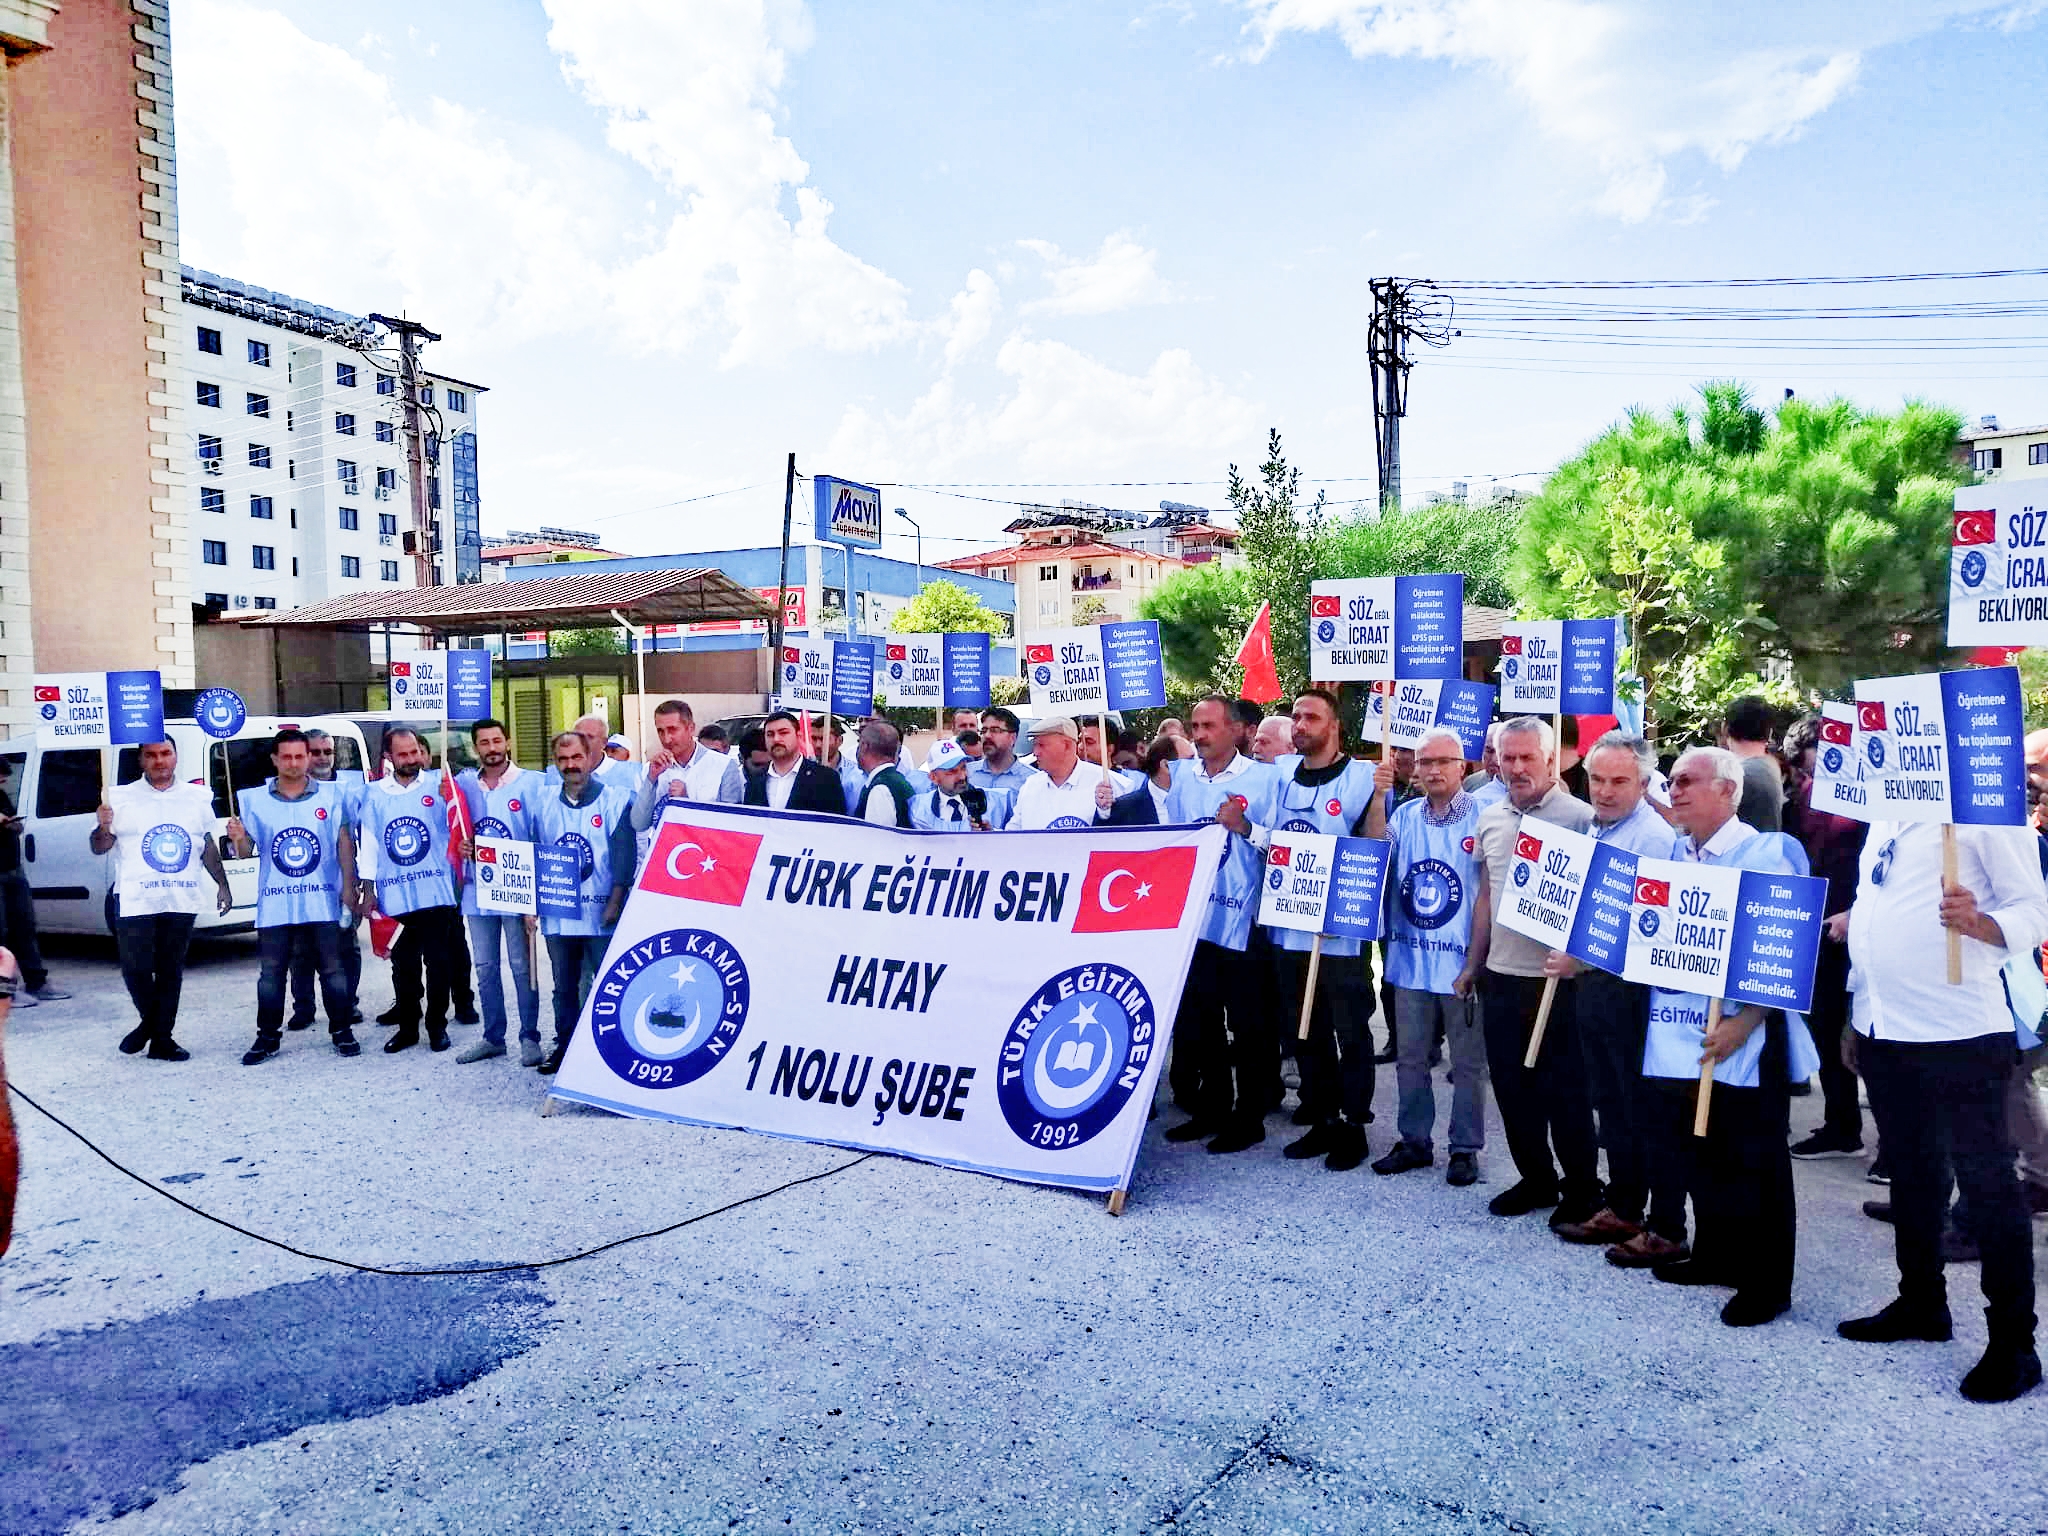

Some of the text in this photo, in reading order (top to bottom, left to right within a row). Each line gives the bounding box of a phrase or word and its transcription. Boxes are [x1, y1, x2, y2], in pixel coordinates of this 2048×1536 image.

[832, 488, 876, 526] Mavi
[2008, 506, 2047, 549] SÖZ
[2006, 554, 2048, 589] İCRA
[1412, 588, 1443, 598] Öğretmen
[1349, 596, 1374, 620] SÖZ
[1979, 594, 2048, 623] BEKLİYORU
[1113, 628, 1147, 639] Öğretmenin
[1349, 624, 1389, 644] İCRAAT
[912, 645, 928, 664] SÖZ
[1061, 643, 1084, 664] SÖZ
[1331, 648, 1388, 664] BEKLİYORUZ!
[1440, 645, 1455, 654] göre
[1528, 636, 1546, 659] SÖZ
[805, 650, 820, 669] SÖZ
[416, 662, 432, 679] SÖZ
[805, 670, 829, 686] İCRAAT
[912, 666, 939, 682] İCRAAT
[1064, 667, 1100, 685] İCRAAT
[1528, 662, 1557, 681] İCRAAT
[68, 686, 89, 703] SÖZ
[417, 681, 443, 696] İCRAAT
[793, 687, 827, 701] BEKLİYORUZ!
[900, 684, 939, 696] BEKLİYORUZ!
[1050, 686, 1101, 703] BEKLİYORUZ!
[1401, 684, 1423, 704] SÖZ
[1515, 683, 1556, 699] BEKLİYORUZ!
[405, 698, 443, 710] BEKLİYORUZ!
[1958, 692, 2006, 710] Öğretmene
[69, 706, 104, 720] İCRAAT
[1398, 704, 1432, 725] İCRAAT
[1894, 701, 1921, 737] SÖZ
[1971, 713, 1998, 728] şiddet
[55, 723, 104, 736] BEKLİYORUZ!
[1461, 725, 1468, 734] 15
[1470, 728, 1484, 737] saat
[1958, 734, 2011, 748] bu toplumun
[1898, 742, 1941, 772] İCRAAT
[1970, 753, 2003, 768] ayıbıdır.
[1885, 776, 1944, 802] BEKLİYORUZ!
[1972, 773, 2003, 786] TEDBİR
[1971, 793, 2004, 808] ALINSIN
[502, 851, 520, 870] SÖZ
[1296, 850, 1316, 873] SÖZ
[1545, 848, 1570, 879] SÖZ
[1608, 857, 1637, 877] Meslek
[503, 872, 531, 890] İCRAAT
[766, 848, 1070, 923] TÜRK EĞİTİM SEN
[1292, 875, 1325, 898] İCRAAT
[1602, 873, 1632, 894] kanunu
[491, 890, 532, 905] BEKLİYORUZ!
[1537, 874, 1576, 911] İCRAAT
[1592, 888, 1633, 914] öğretmene
[1769, 885, 1792, 900] Tüm
[1276, 897, 1321, 916] BEKLİYORUZ!
[1679, 886, 1728, 922] SÖZ DEĞİL
[1746, 902, 1812, 922] öğretmenler
[1517, 897, 1568, 932] BEKLİYORUZ!
[1595, 908, 1621, 928] destek
[1588, 922, 1617, 944] kanunu
[1675, 918, 1726, 952] İCRAAT
[1757, 924, 1794, 939] sadece
[1588, 943, 1608, 960] olsun
[1752, 940, 1793, 958] kadrolu
[1650, 947, 1720, 976] BEKLİYORUZ!
[1748, 960, 1793, 979] istihdam
[826, 954, 948, 1014] HATAY
[1738, 979, 1797, 1000] edilmelidir.
[595, 934, 743, 1056] TÜRKİYE KAMU-SEN
[1650, 1007, 1708, 1025] EĞİTİM-
[1002, 966, 1151, 1090] TÜRK EĞİTİM-SEN
[628, 1059, 673, 1082] 1992
[746, 1040, 976, 1127] 1 NOLU ŞUBE
[1030, 1121, 1079, 1147] 1992
